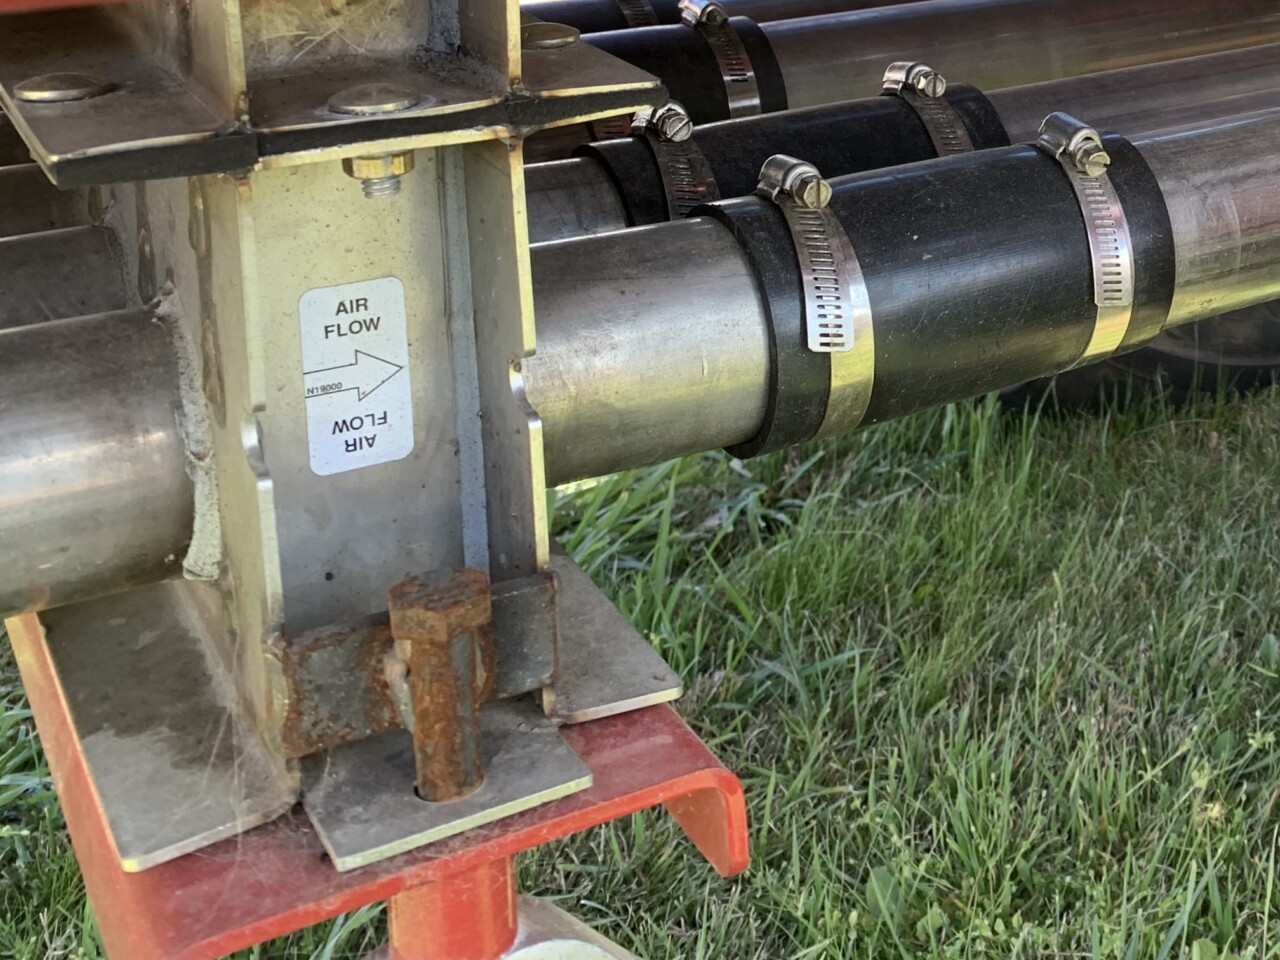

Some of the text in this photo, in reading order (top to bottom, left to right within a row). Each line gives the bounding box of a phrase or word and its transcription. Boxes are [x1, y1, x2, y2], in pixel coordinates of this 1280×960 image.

[335, 297, 369, 316] AIR
[324, 316, 381, 339] FLOW
[306, 382, 343, 396] N19000
[331, 410, 388, 435] FLOW
[344, 434, 377, 453] AIR
